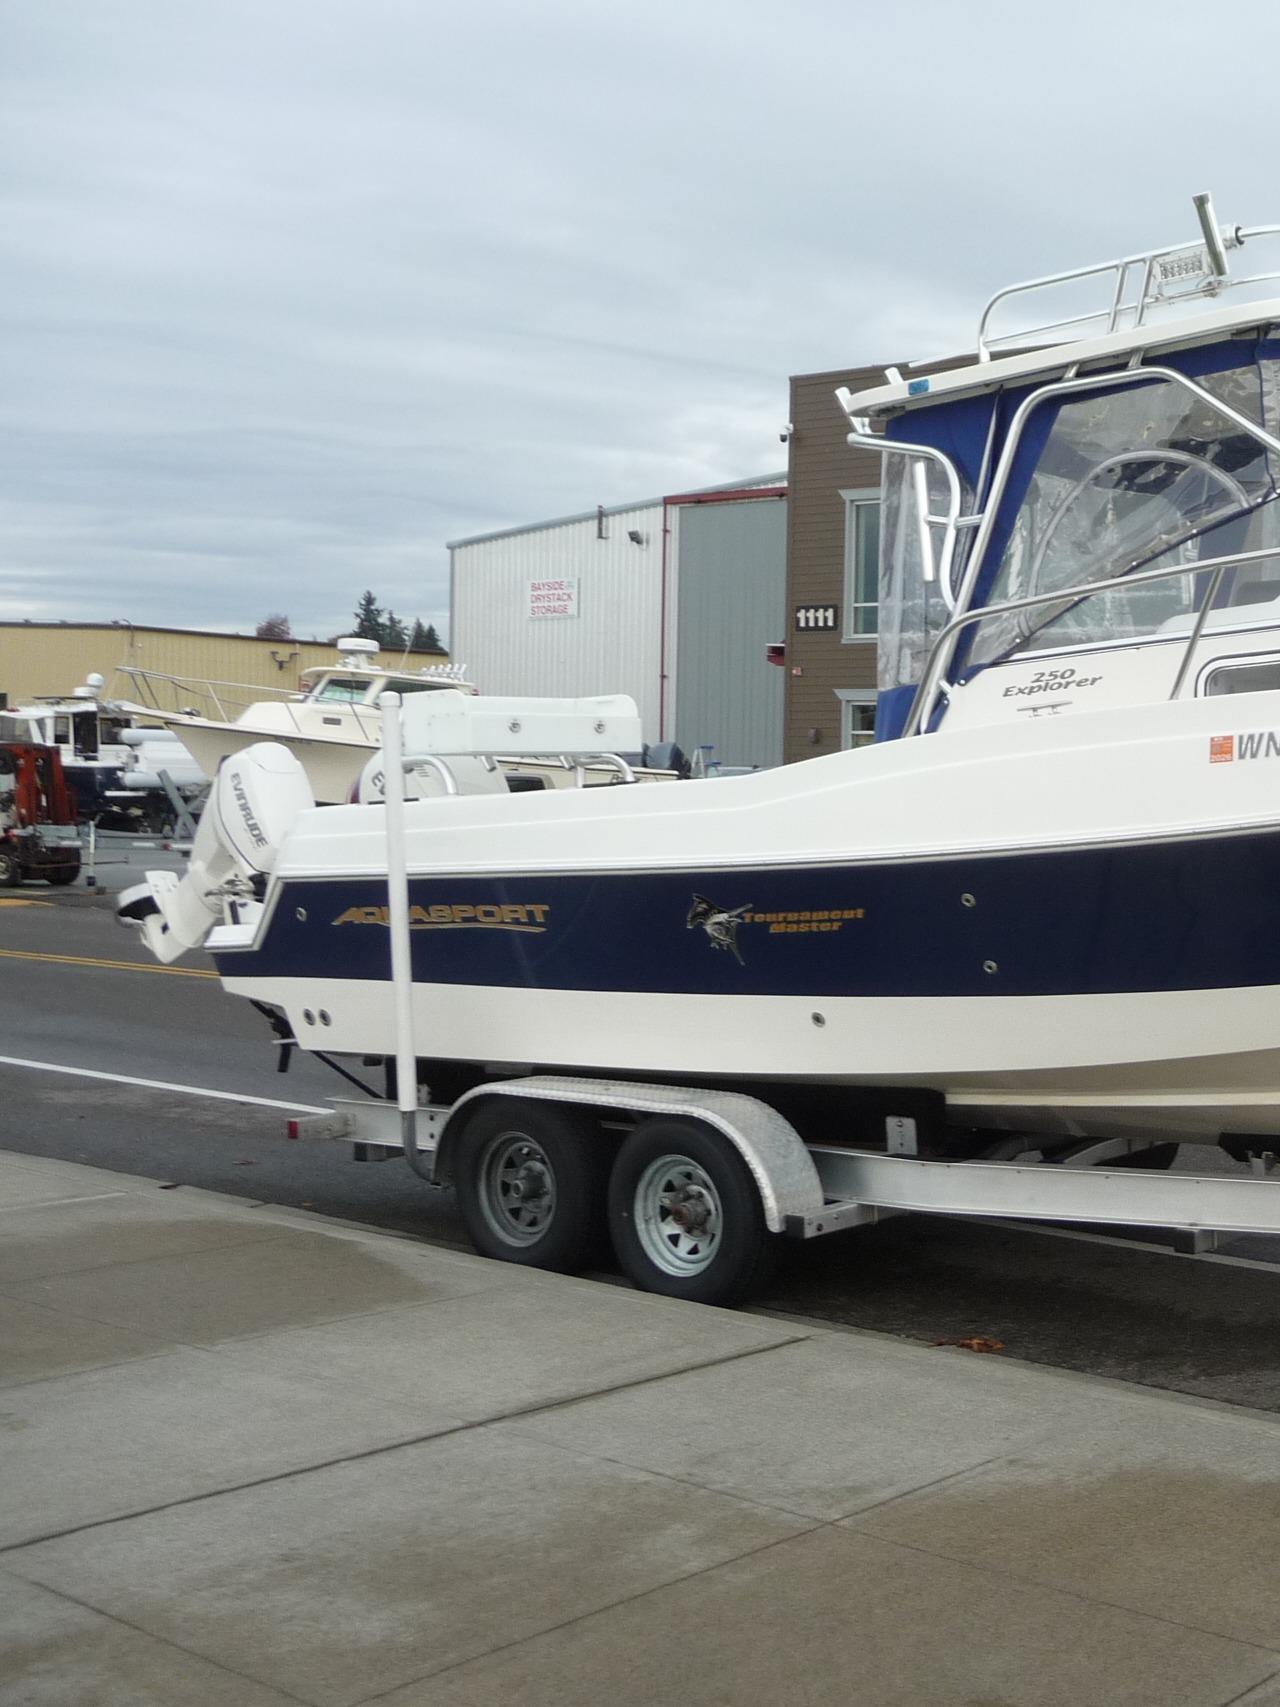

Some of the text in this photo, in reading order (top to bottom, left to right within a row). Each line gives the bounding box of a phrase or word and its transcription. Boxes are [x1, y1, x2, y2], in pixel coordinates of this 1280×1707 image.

[530, 580, 565, 592] BAYSIDE
[530, 592, 574, 604] DRYSTACK
[530, 604, 569, 616] STORAGE
[796, 608, 834, 627] 1111
[1031, 668, 1076, 684] 250
[1002, 676, 1103, 698] Explorer
[230, 772, 269, 849] EVINRUDE
[743, 908, 865, 923] Tournament
[768, 921, 843, 934] Master
